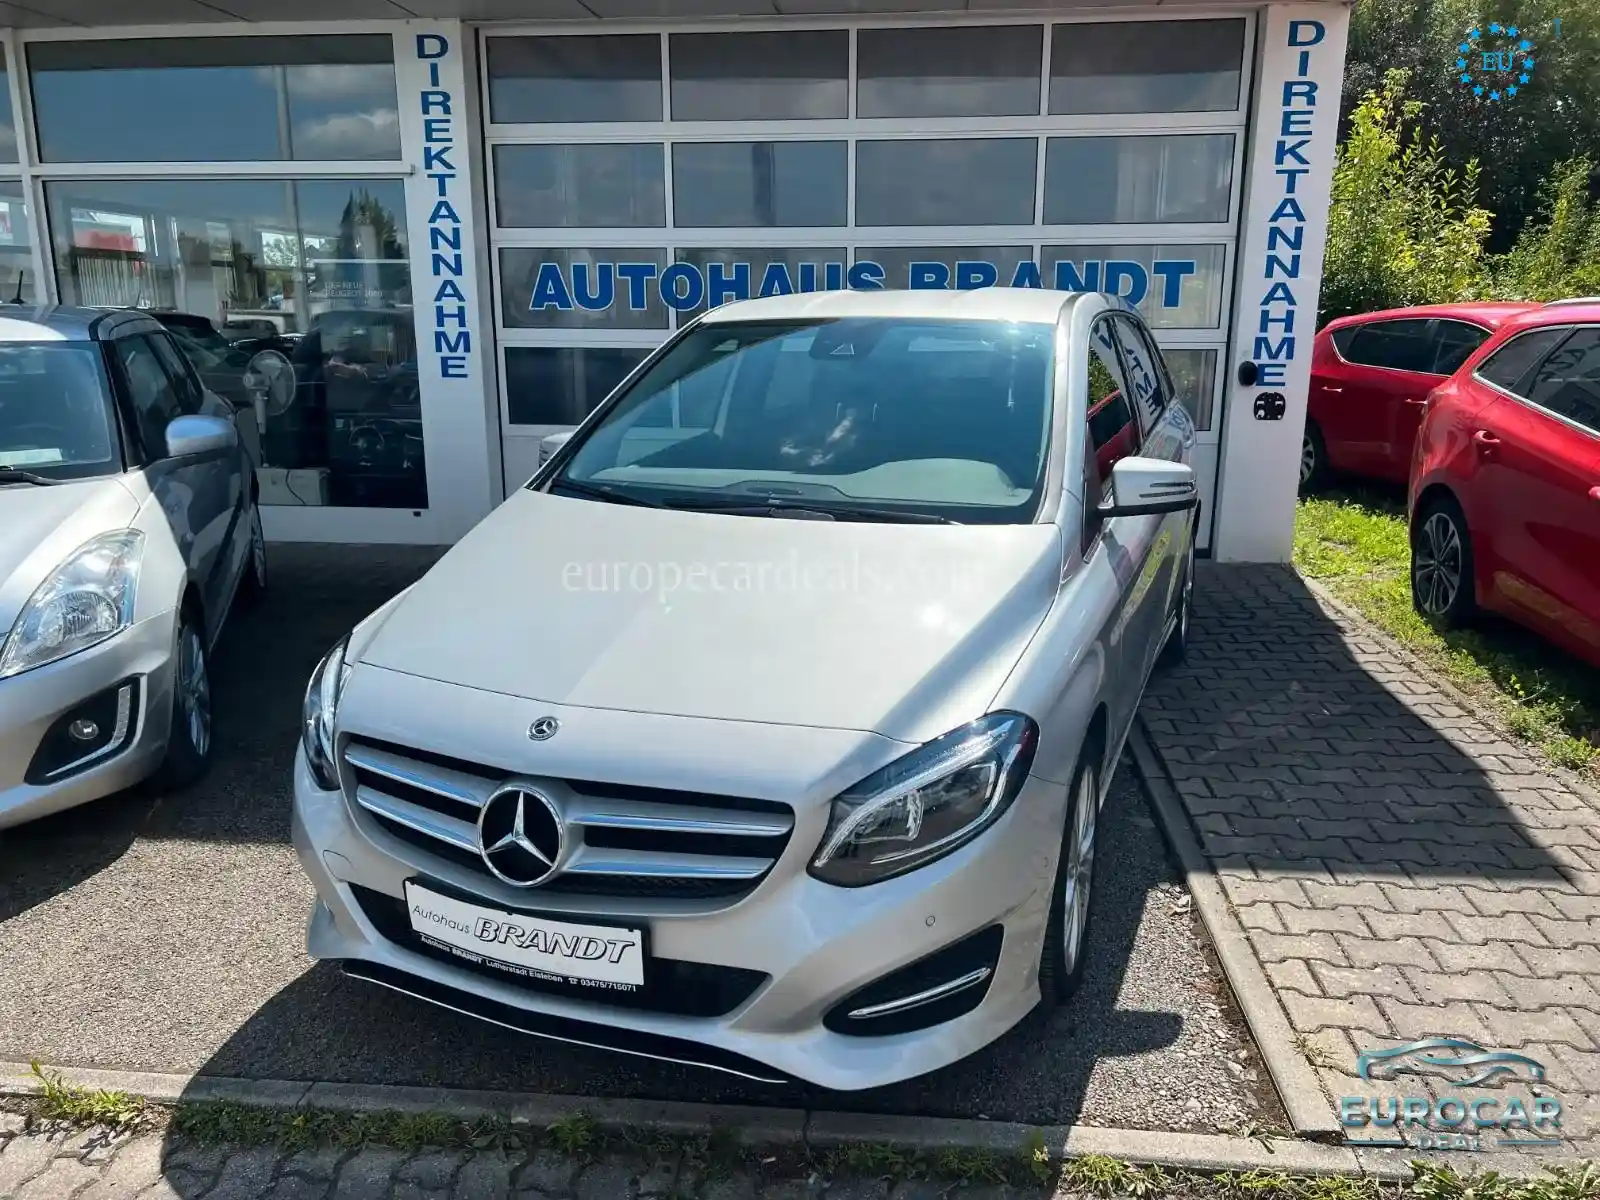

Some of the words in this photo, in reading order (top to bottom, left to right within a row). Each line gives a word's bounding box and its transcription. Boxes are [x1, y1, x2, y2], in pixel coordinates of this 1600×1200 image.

[416, 34, 471, 379] DIREKTANNAHME
[529, 261, 886, 311] AUTOHAUS
[1252, 20, 1326, 387] DIREKTANNAHME
[412, 904, 470, 933] Autohaus
[474, 917, 635, 963] BRANDT
